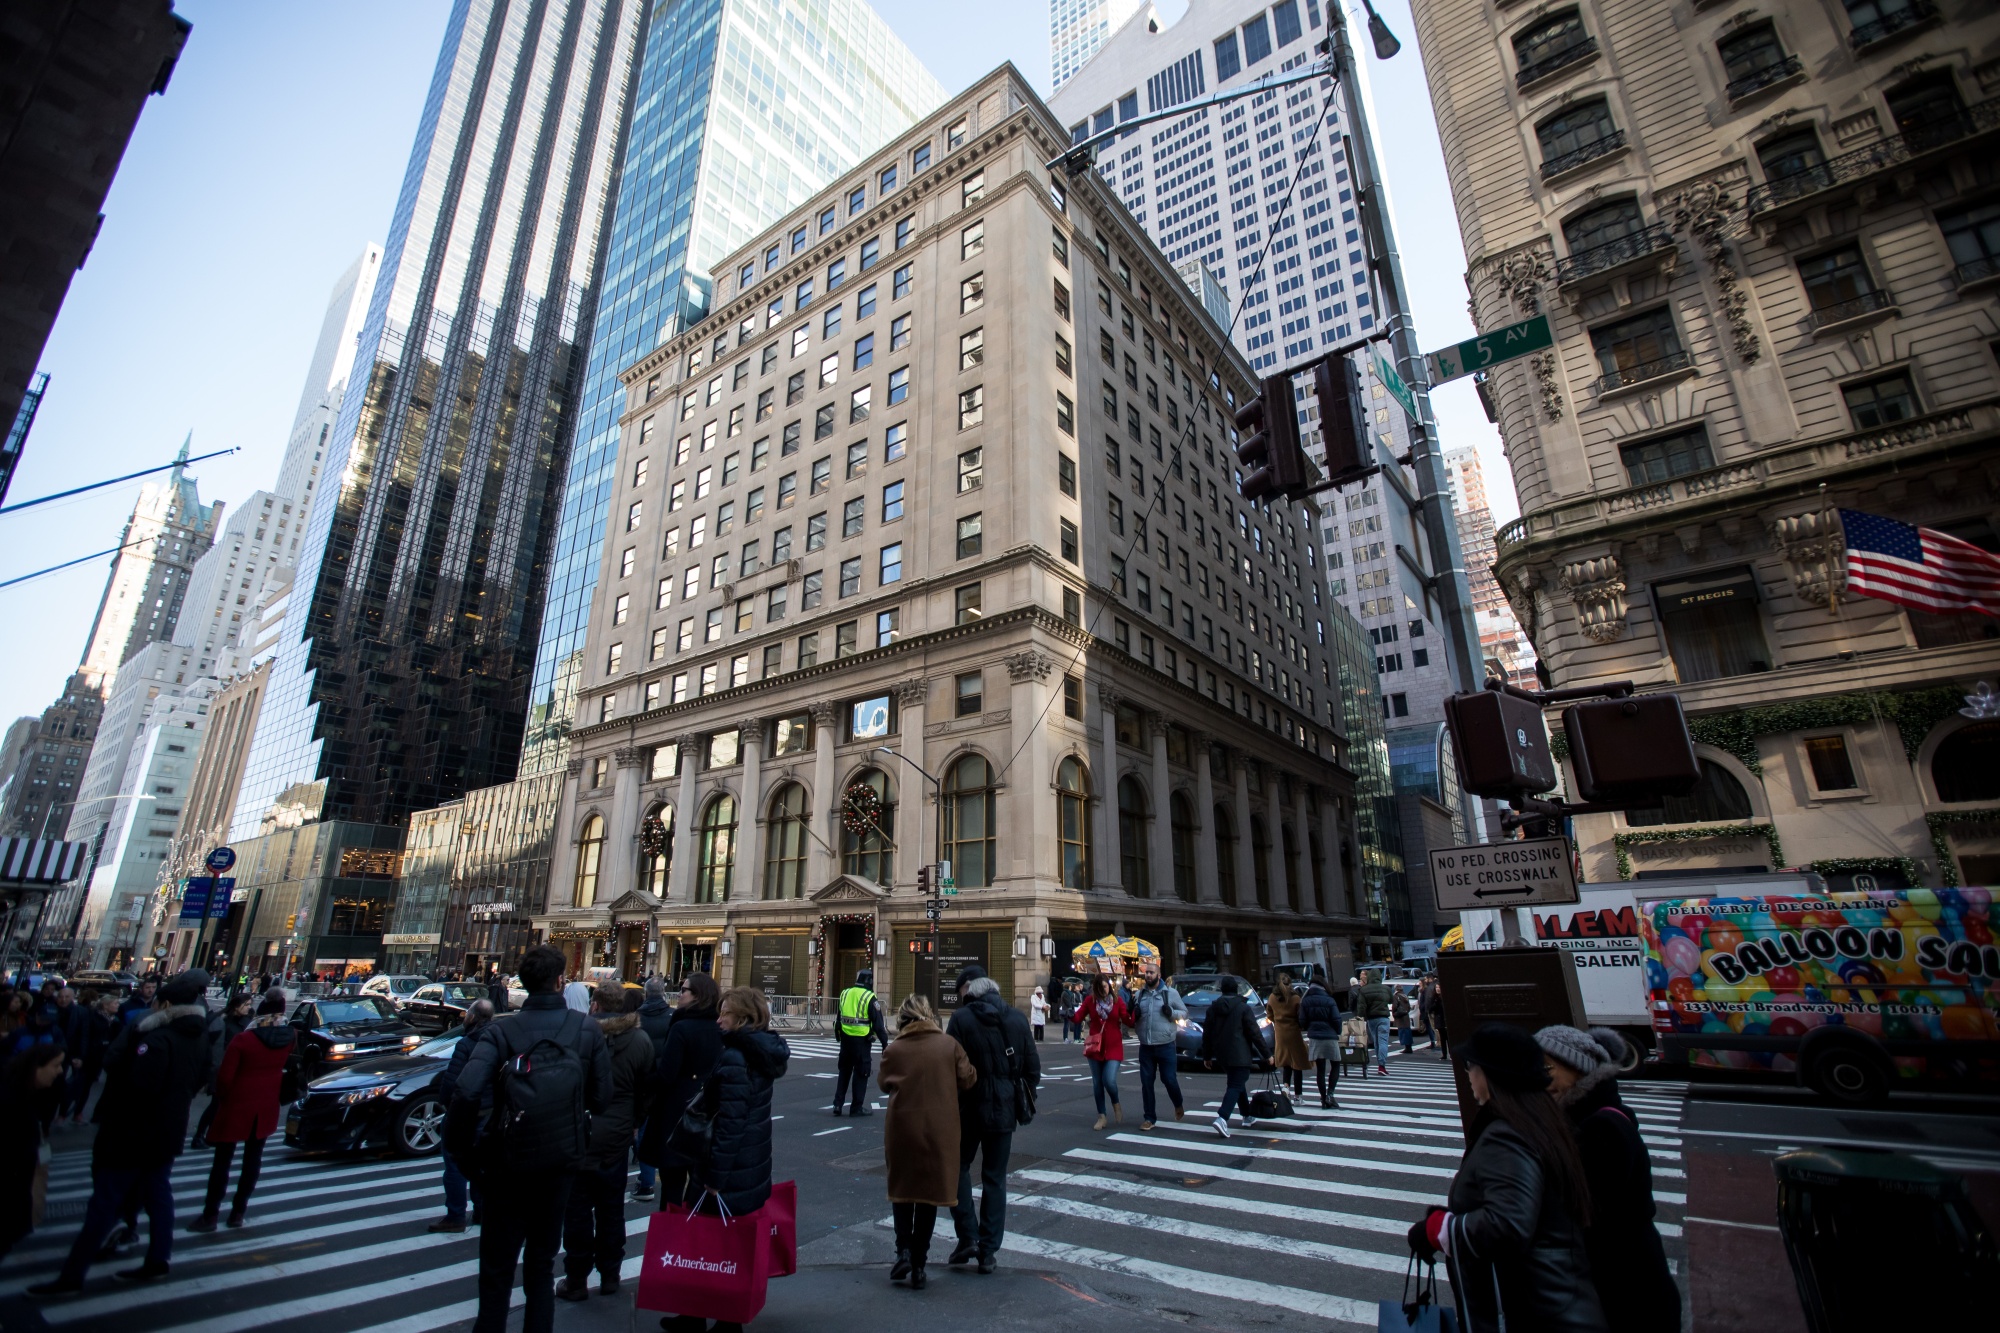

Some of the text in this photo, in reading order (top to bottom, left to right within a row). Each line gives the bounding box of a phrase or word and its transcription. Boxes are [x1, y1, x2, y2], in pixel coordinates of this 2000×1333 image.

[1476, 323, 1529, 365] 5 AV
[1680, 589, 1735, 605] ST REGIS
[1437, 846, 1561, 870] NO PED. CROSSING
[1640, 842, 1755, 860] HARRY WINSTON
[1446, 866, 1559, 887] USE CROSSWALK
[1668, 899, 1900, 916] DELIVERY & DECORATING
[1541, 938, 1639, 950] EASING, INC.
[1575, 954, 1641, 968] SALEM
[1708, 925, 1906, 986] BALLOON
[1684, 1002, 1942, 1016] 133 West Broadway NYC 10013
[673, 1253, 737, 1275] American Girl
